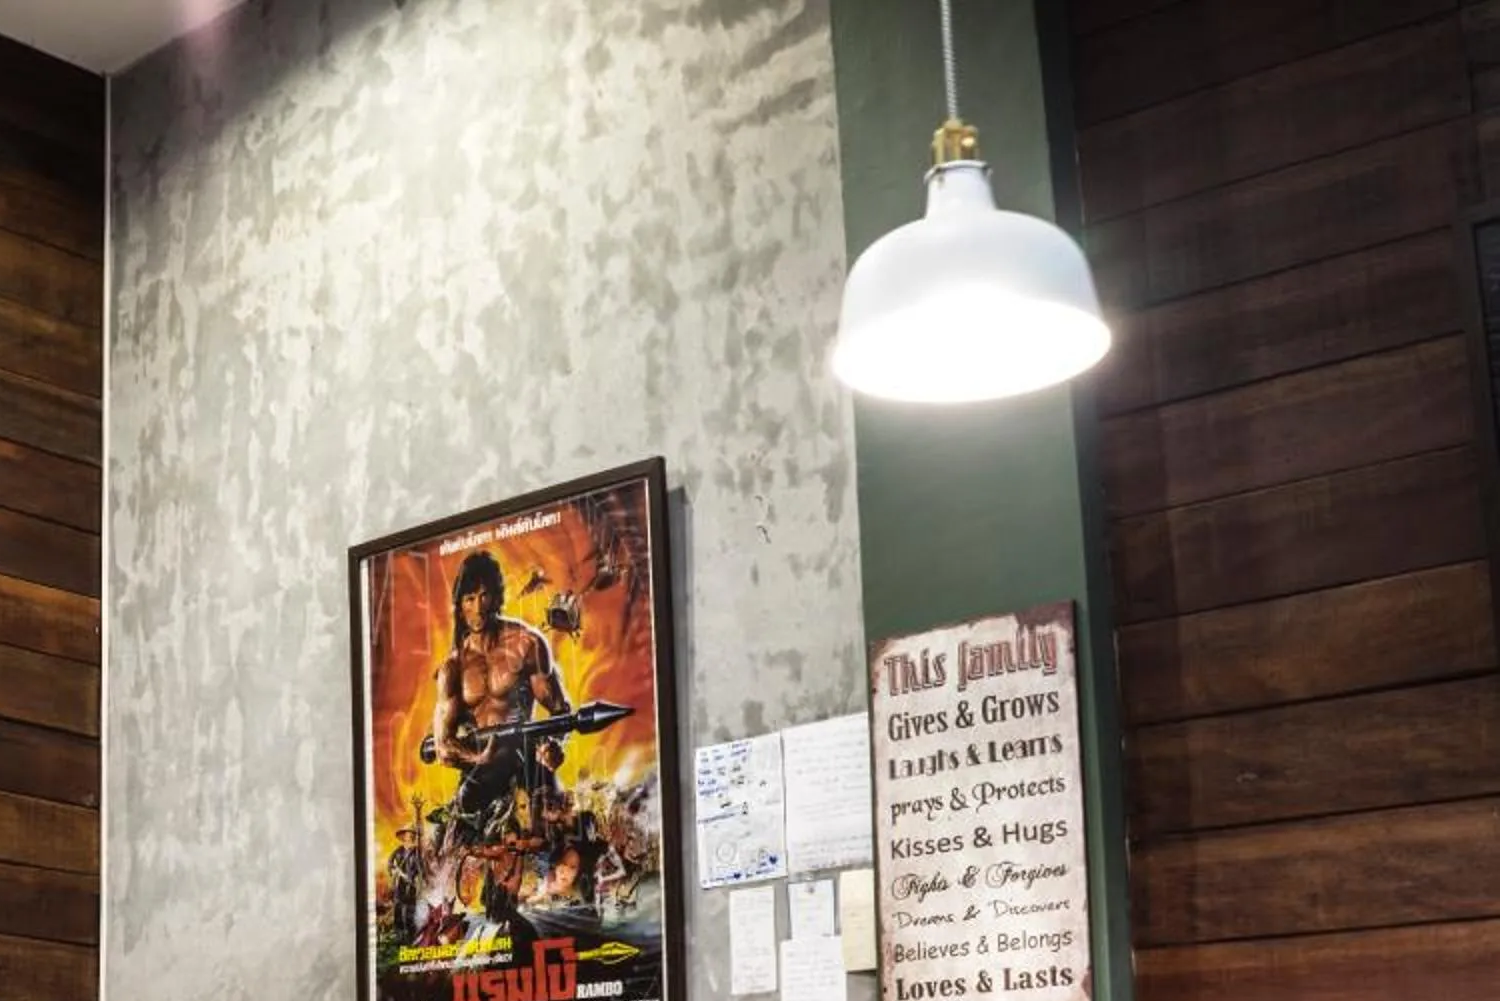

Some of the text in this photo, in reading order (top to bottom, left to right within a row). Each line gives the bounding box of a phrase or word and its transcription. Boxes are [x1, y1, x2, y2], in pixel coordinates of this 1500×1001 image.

[884, 648, 947, 696] This
[888, 691, 1060, 742] Gives & Grows
[888, 733, 1063, 780] Laughs & Learns
[949, 787, 969, 811] &
[971, 775, 1066, 814] Protects
[890, 819, 1068, 860] Kisses & Hugs
[891, 861, 1068, 903] Fights & Forgives
[963, 905, 980, 921] &
[894, 930, 1073, 963] Believes & Belongs
[576, 980, 623, 999] RAMBO
[895, 965, 1074, 1001] Loves & Lasts
